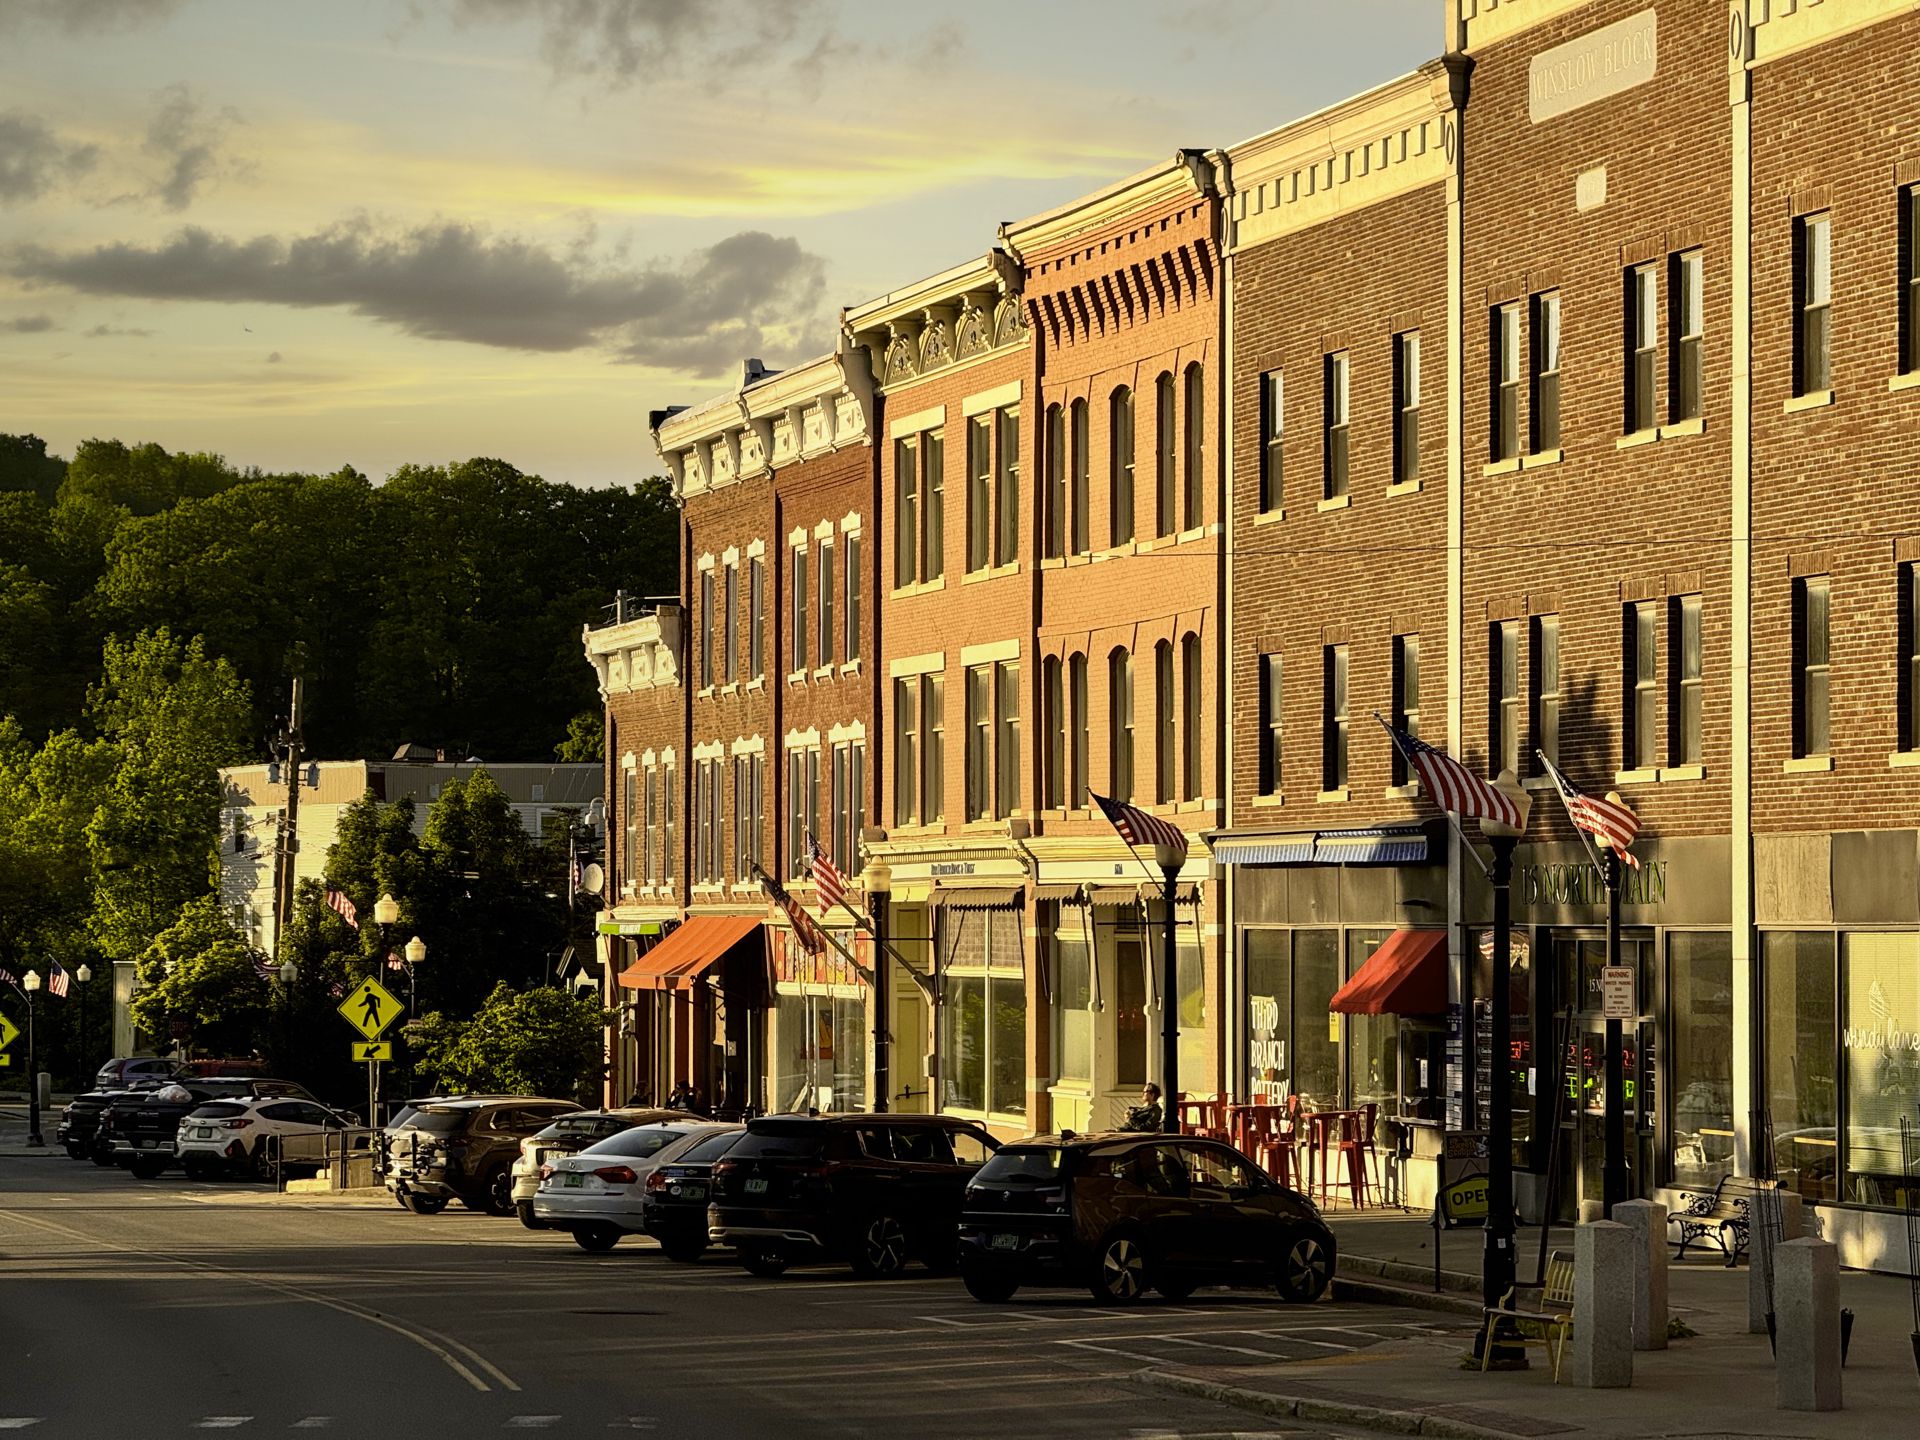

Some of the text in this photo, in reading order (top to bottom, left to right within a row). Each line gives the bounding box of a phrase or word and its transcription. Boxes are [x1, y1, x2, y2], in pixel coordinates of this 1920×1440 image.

[1532, 27, 1652, 101] WINSLOW BLOCK
[1543, 862, 1607, 905] NORTH
[1251, 1040, 1285, 1077] BRANCH
[1844, 1023, 1888, 1060] windy
[1452, 1188, 1489, 1206] OPE
